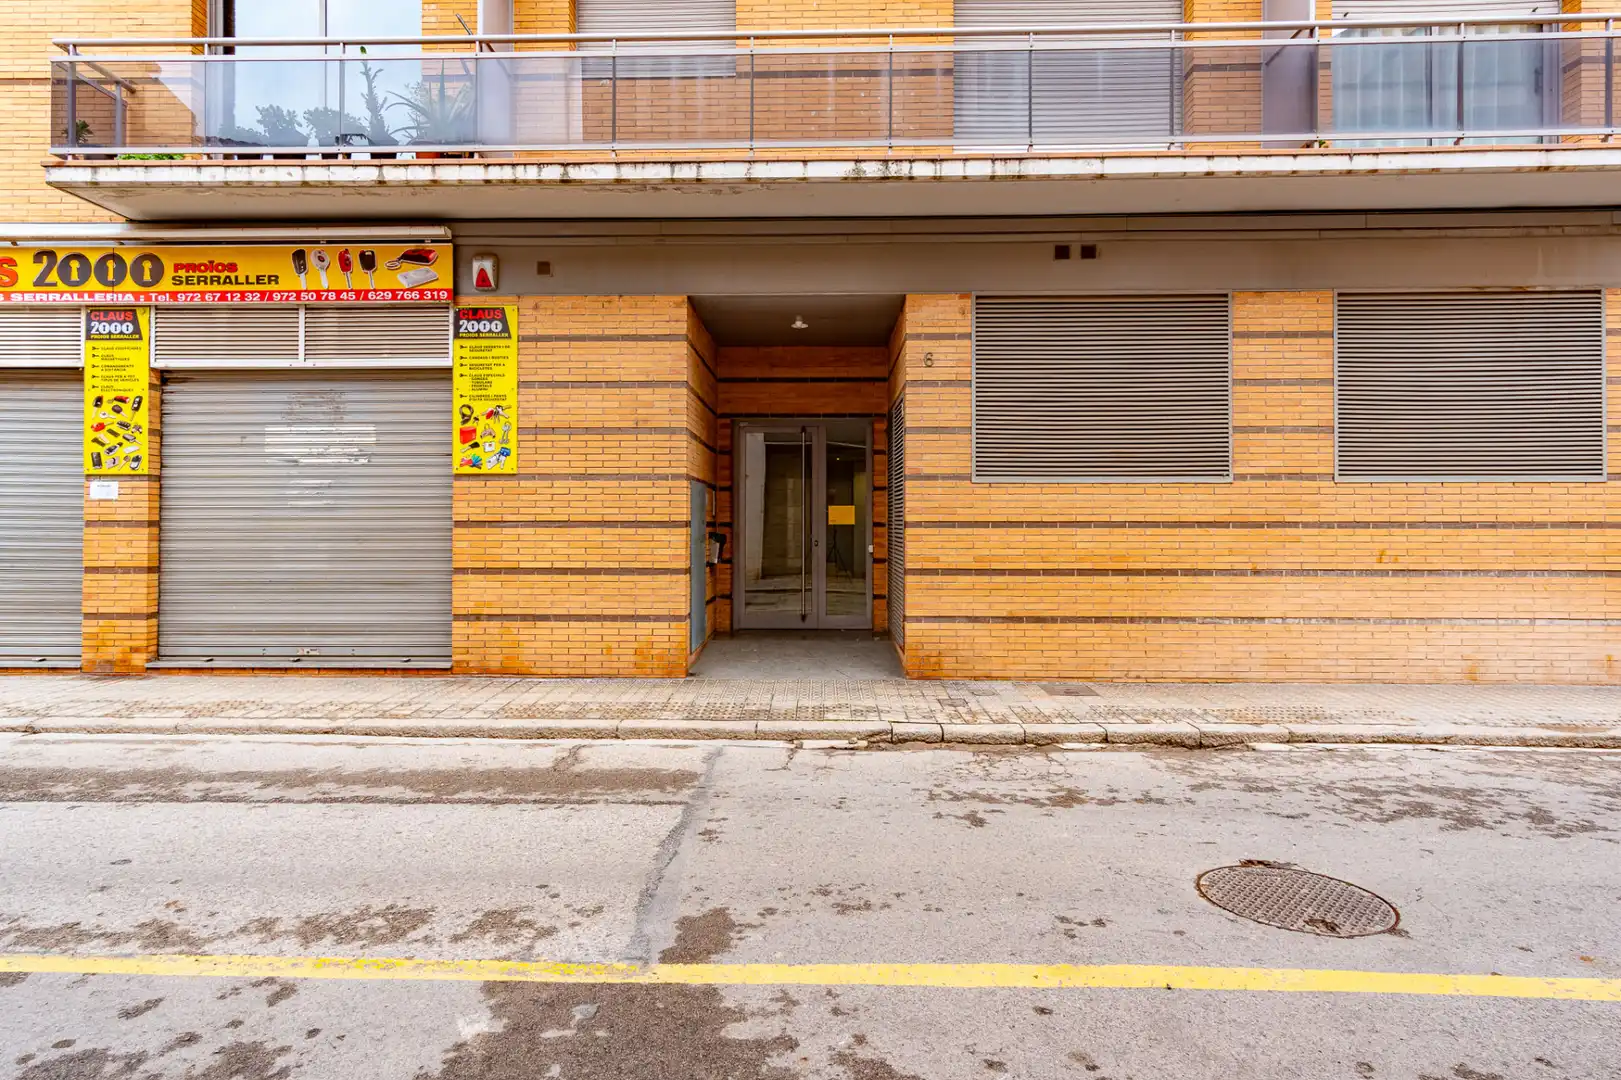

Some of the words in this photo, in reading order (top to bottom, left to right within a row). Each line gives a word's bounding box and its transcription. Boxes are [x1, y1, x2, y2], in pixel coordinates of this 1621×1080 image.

[32, 249, 165, 288] 2000
[171, 274, 280, 286] SERRALLER
[10, 292, 135, 302] SERRALLERIA
[149, 292, 173, 302] Tel.
[177, 292, 201, 302] 972
[205, 292, 222, 302] 67
[226, 292, 241, 302] 12
[244, 292, 261, 301] 32
[272, 292, 297, 301] 972
[300, 292, 317, 301] 50
[320, 292, 336, 301] 78
[340, 292, 356, 301] 45
[368, 291, 392, 301] 629
[396, 291, 420, 301] 766
[424, 291, 448, 300] 319
[91, 311, 133, 320] CLAUS
[459, 309, 503, 319] CLAUS
[90, 321, 134, 334] 2000
[459, 319, 503, 333] 2000
[924, 352, 934, 368] 6
